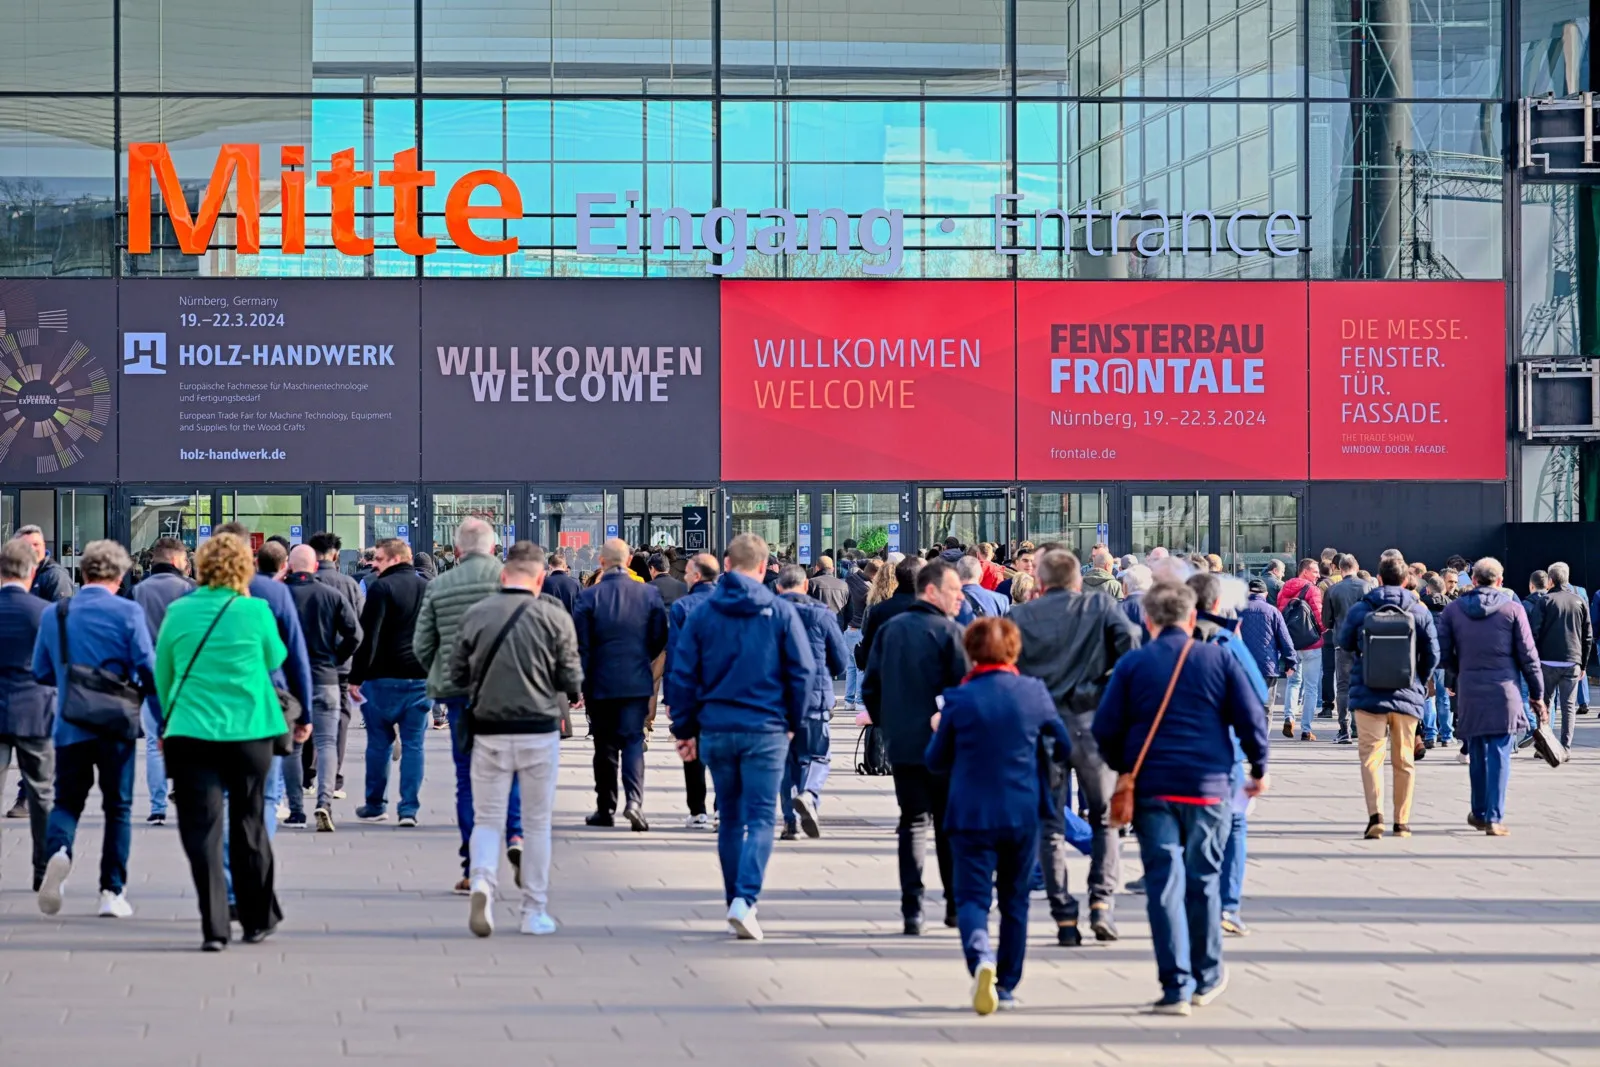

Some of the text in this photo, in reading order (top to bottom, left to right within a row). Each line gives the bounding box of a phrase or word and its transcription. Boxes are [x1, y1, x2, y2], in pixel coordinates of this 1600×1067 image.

[128, 142, 523, 257] Mitte
[576, 190, 1300, 275] Eingang Entrance
[179, 296, 278, 309] Nürnberg, Germany
[1050, 324, 1264, 354] FENSTERBAU
[1341, 319, 1468, 340] DIE MESSE.
[179, 344, 395, 366] HOLZ-HANDWERK
[437, 346, 702, 376] WILLKOMMEN
[754, 338, 980, 368] WILLKOMMEN
[1341, 347, 1446, 368] FENSTER.
[470, 371, 669, 402] WELCOME
[1051, 358, 1265, 394] FRONTALE
[1340, 370, 1391, 396] TÜR.
[180, 382, 369, 392] Europäische Fachmesse für Maschinentechnologie
[754, 380, 915, 409] WELCOME
[180, 394, 261, 404] und Fertigungsbedarf
[180, 412, 392, 421] European Trade Fair for Machine Technology, Equipment
[1051, 410, 1137, 428] Nürnberg,
[1341, 402, 1448, 423] FASSADE.
[196, 423, 228, 432] Supplies
[229, 423, 240, 431] for
[242, 423, 256, 431] the
[257, 423, 281, 431] Wood
[283, 423, 306, 431] Crafts
[1342, 434, 1417, 442] THE TRADE SHOW.
[180, 448, 286, 460] holz-handwerk.de
[1050, 448, 1116, 459] frontale.de
[1342, 445, 1448, 454] WINDOW. DOOR. FACADE.
